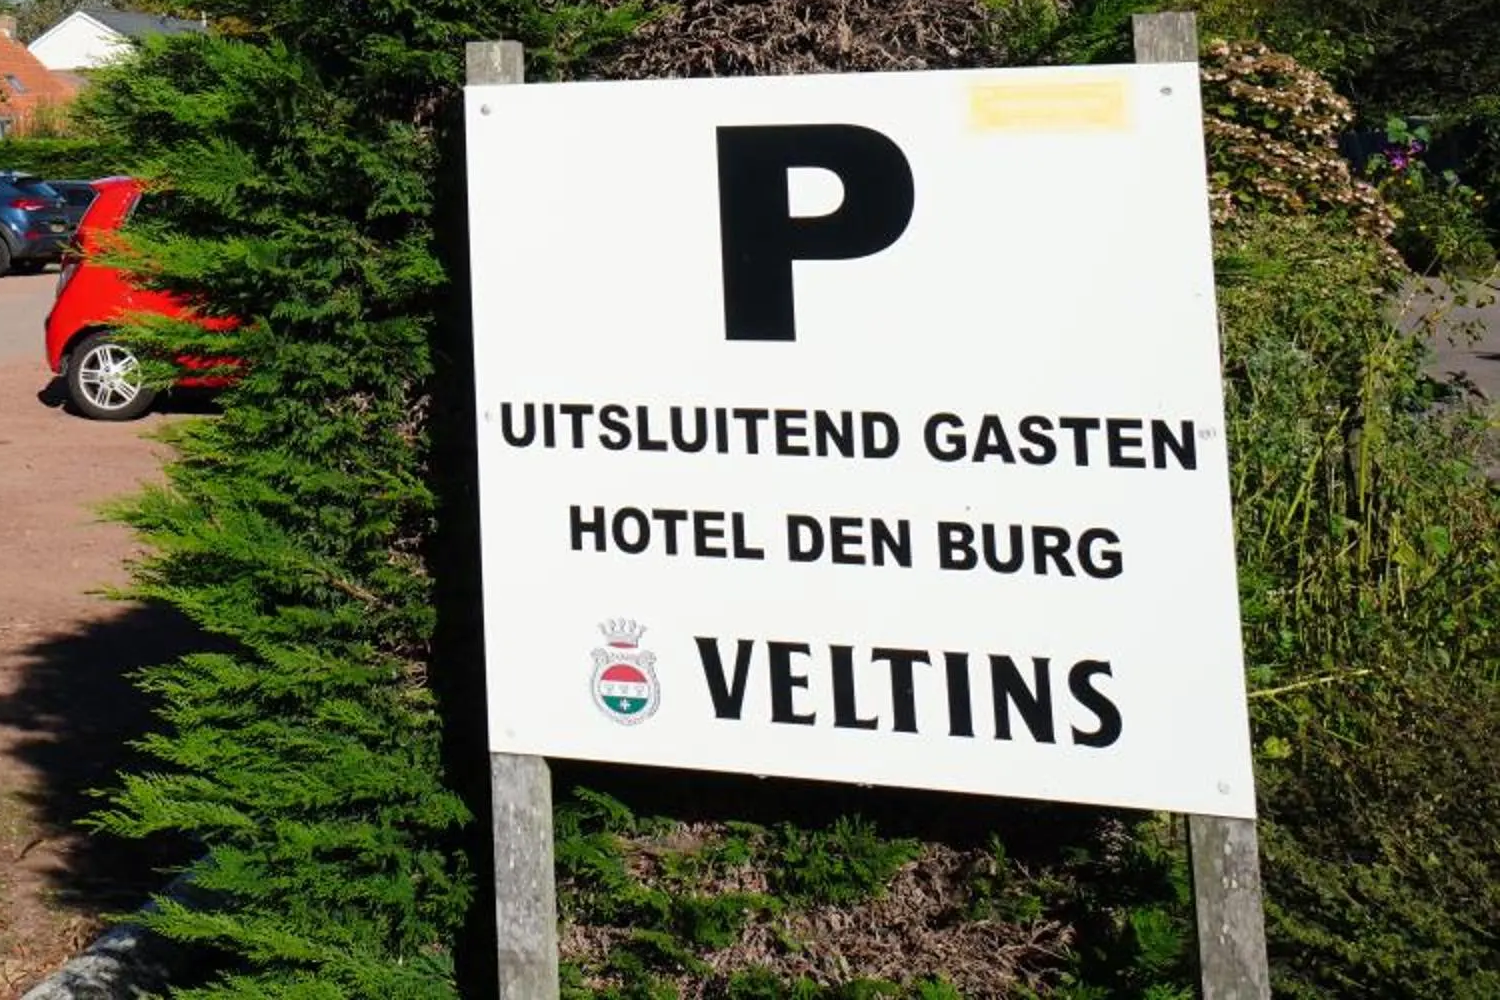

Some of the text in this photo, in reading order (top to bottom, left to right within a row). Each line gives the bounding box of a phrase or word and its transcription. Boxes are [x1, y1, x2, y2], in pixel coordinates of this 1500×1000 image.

[716, 123, 915, 342] P
[501, 402, 1197, 471] UITSLUITEND GASTEN
[570, 505, 1123, 579] HOTEL DEN BURG
[695, 637, 1123, 749] VELTINS
